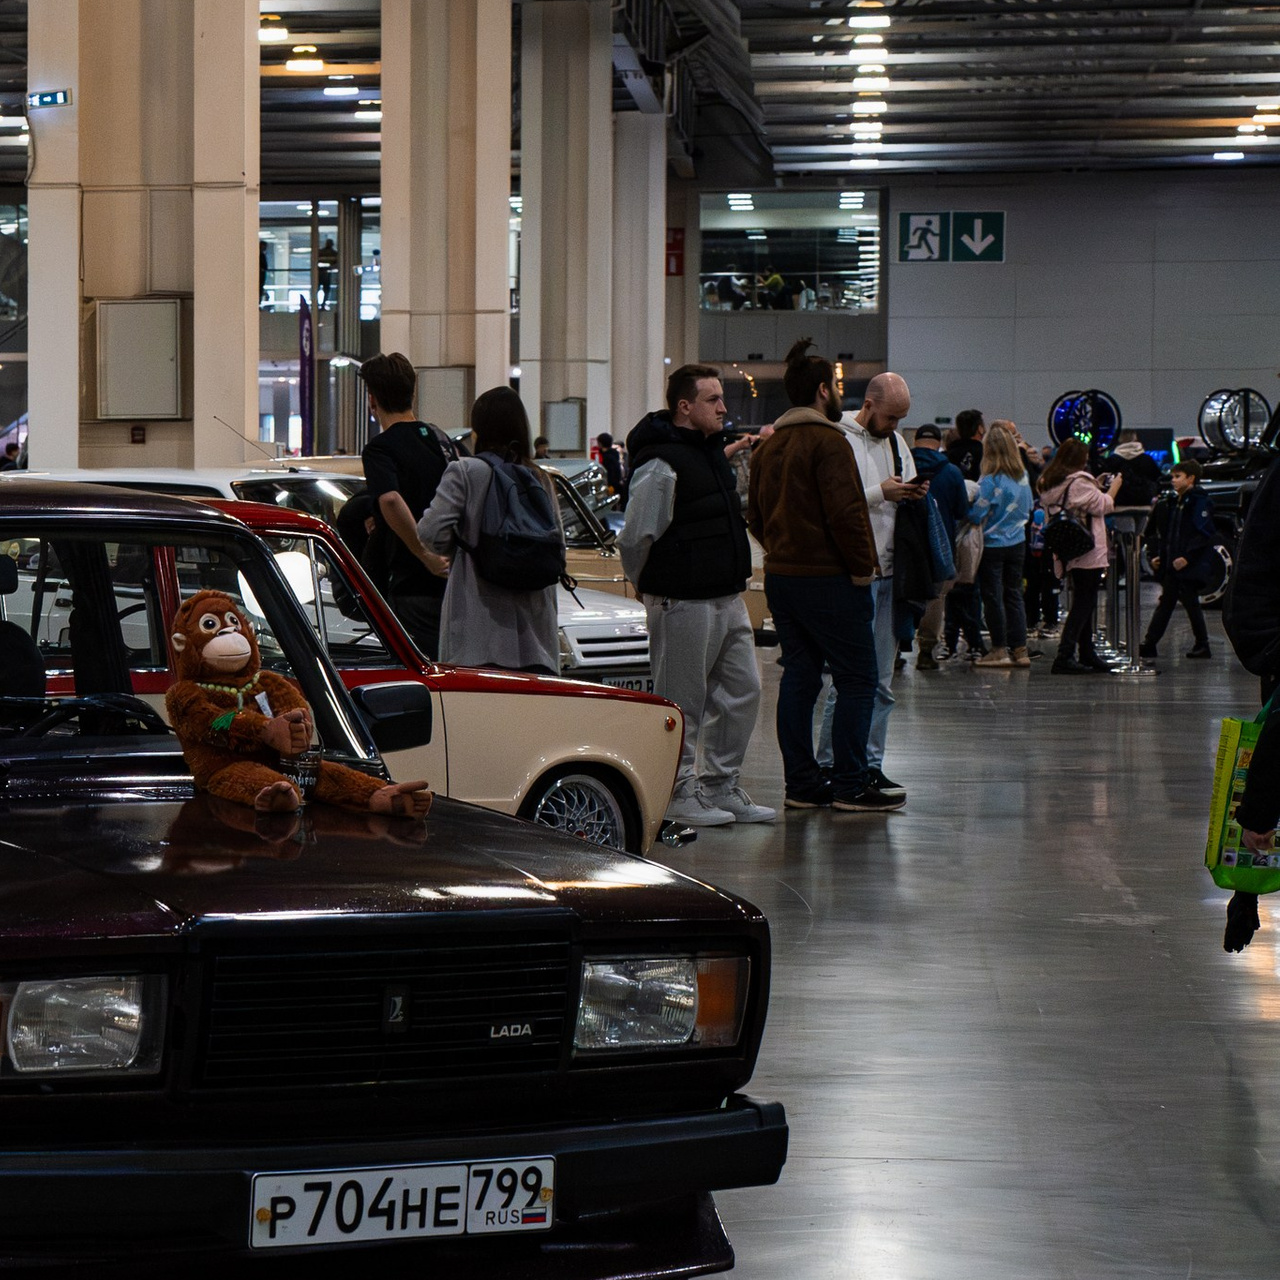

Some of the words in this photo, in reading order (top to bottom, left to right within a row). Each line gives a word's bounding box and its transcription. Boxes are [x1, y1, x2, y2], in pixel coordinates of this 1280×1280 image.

[490, 1023, 533, 1039] LADA
[472, 1166, 543, 1211] 799
[485, 1209, 520, 1226] RUS
